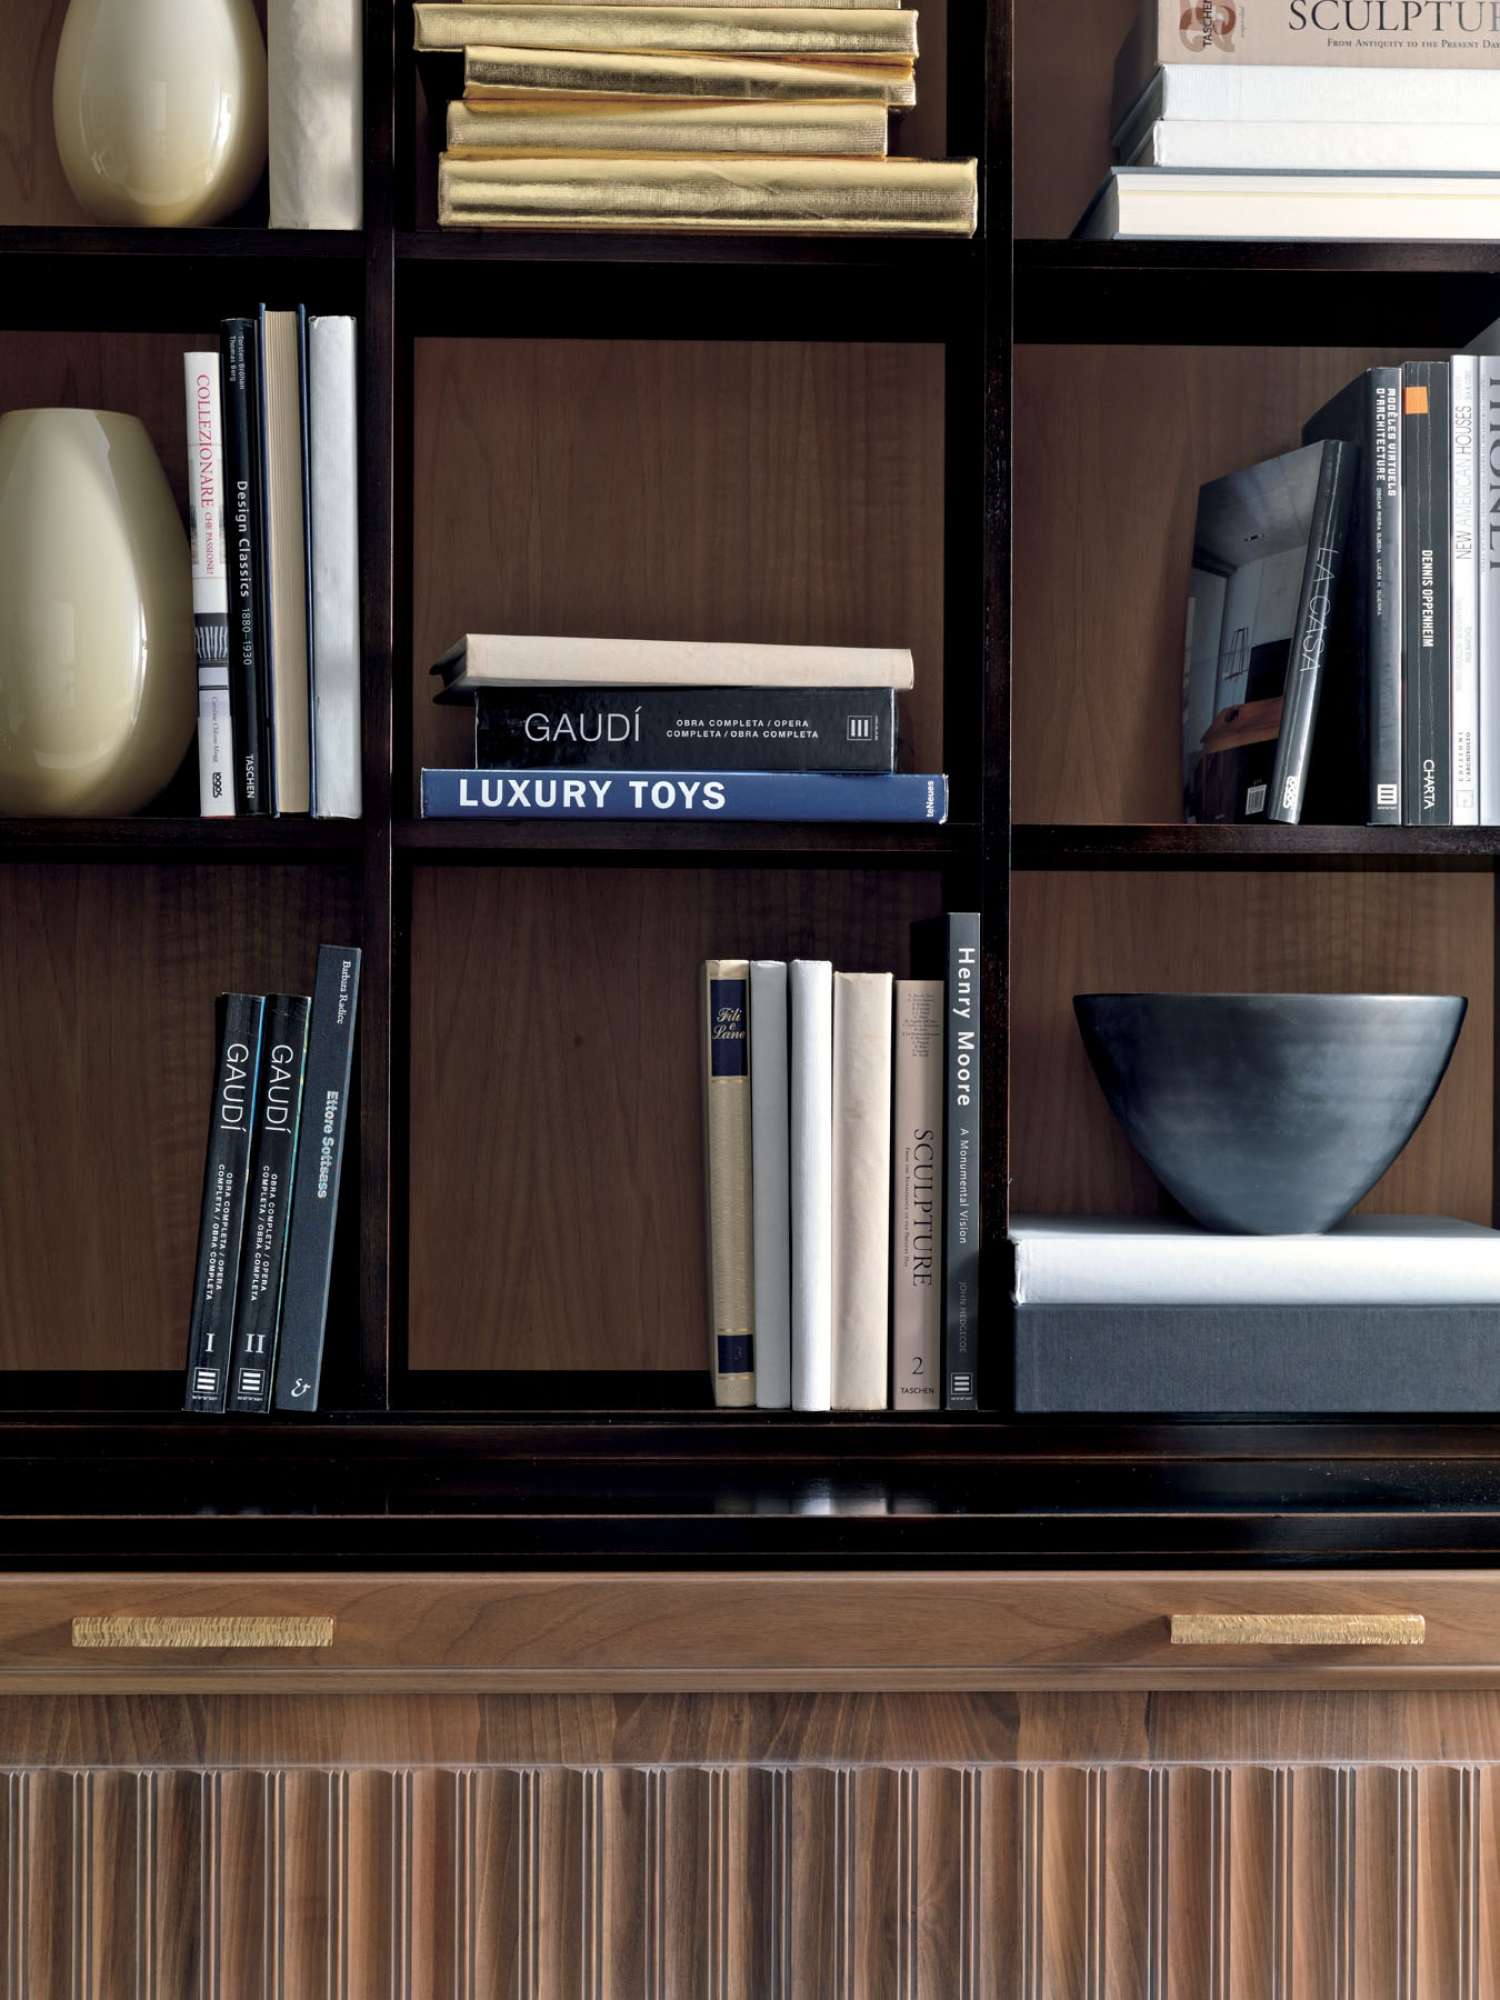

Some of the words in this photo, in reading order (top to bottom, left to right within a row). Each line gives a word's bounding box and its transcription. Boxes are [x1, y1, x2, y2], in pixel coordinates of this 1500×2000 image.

[1202, 0, 1212, 47] TASCHE
[196, 374, 214, 508] COLLEZIONARE
[1375, 388, 1386, 481] D'ARCHITECTURE
[1454, 405, 1472, 455] HOUSES
[1387, 443, 1397, 497] VIRTUELS
[1455, 458, 1472, 528] AMERICAN
[204, 512, 213, 527] CHE
[235, 481, 250, 532] Design
[239, 538, 252, 598] Classics
[1312, 547, 1338, 581] LA
[1422, 550, 1434, 586] DENNIS
[1455, 531, 1472, 560] NEW
[1300, 596, 1331, 672] CASA
[1422, 588, 1434, 648] OPPENHEIM
[524, 706, 642, 742] GAUDÍ
[666, 730, 722, 738] COMPLETA
[731, 730, 758, 738] OBRA
[763, 731, 819, 739] COMPLETA
[245, 753, 255, 799] TASCHEN
[459, 779, 612, 807] LUXURY
[629, 781, 726, 810] TOYS
[927, 780, 935, 817] teNeues
[1423, 760, 1435, 810] CHARTA
[339, 960, 351, 993] Barbara
[953, 948, 976, 1018] Henry
[337, 994, 348, 1024] Radice
[220, 1043, 249, 1132] GAUDÍ
[264, 1044, 294, 1134] GAUDÍ
[957, 1032, 975, 1106] Moore
[322, 1091, 339, 1134] Ettore
[959, 1128, 968, 1136] A
[214, 1164, 225, 1212] COMPLETA
[225, 1172, 233, 1197] OBRA
[258, 1165, 270, 1214] COMPLETA
[269, 1173, 278, 1198] OBRA
[318, 1137, 334, 1198] Sottsass
[959, 1140, 969, 1207] Monumental
[219, 1201, 231, 1250] COMPLETA
[264, 1202, 275, 1250] COMPLETA
[913, 1129, 934, 1287] SCULPTURE
[959, 1210, 969, 1244] Vision
[211, 1223, 219, 1248] OBRA
[255, 1224, 264, 1249] OBRA
[205, 1251, 216, 1300] COMPLETA
[215, 1260, 224, 1290] OPERA
[251, 1253, 261, 1301] COMPLETA
[260, 1261, 269, 1291] OPERA
[244, 1333, 266, 1353] II
[912, 1357, 924, 1375] 2
